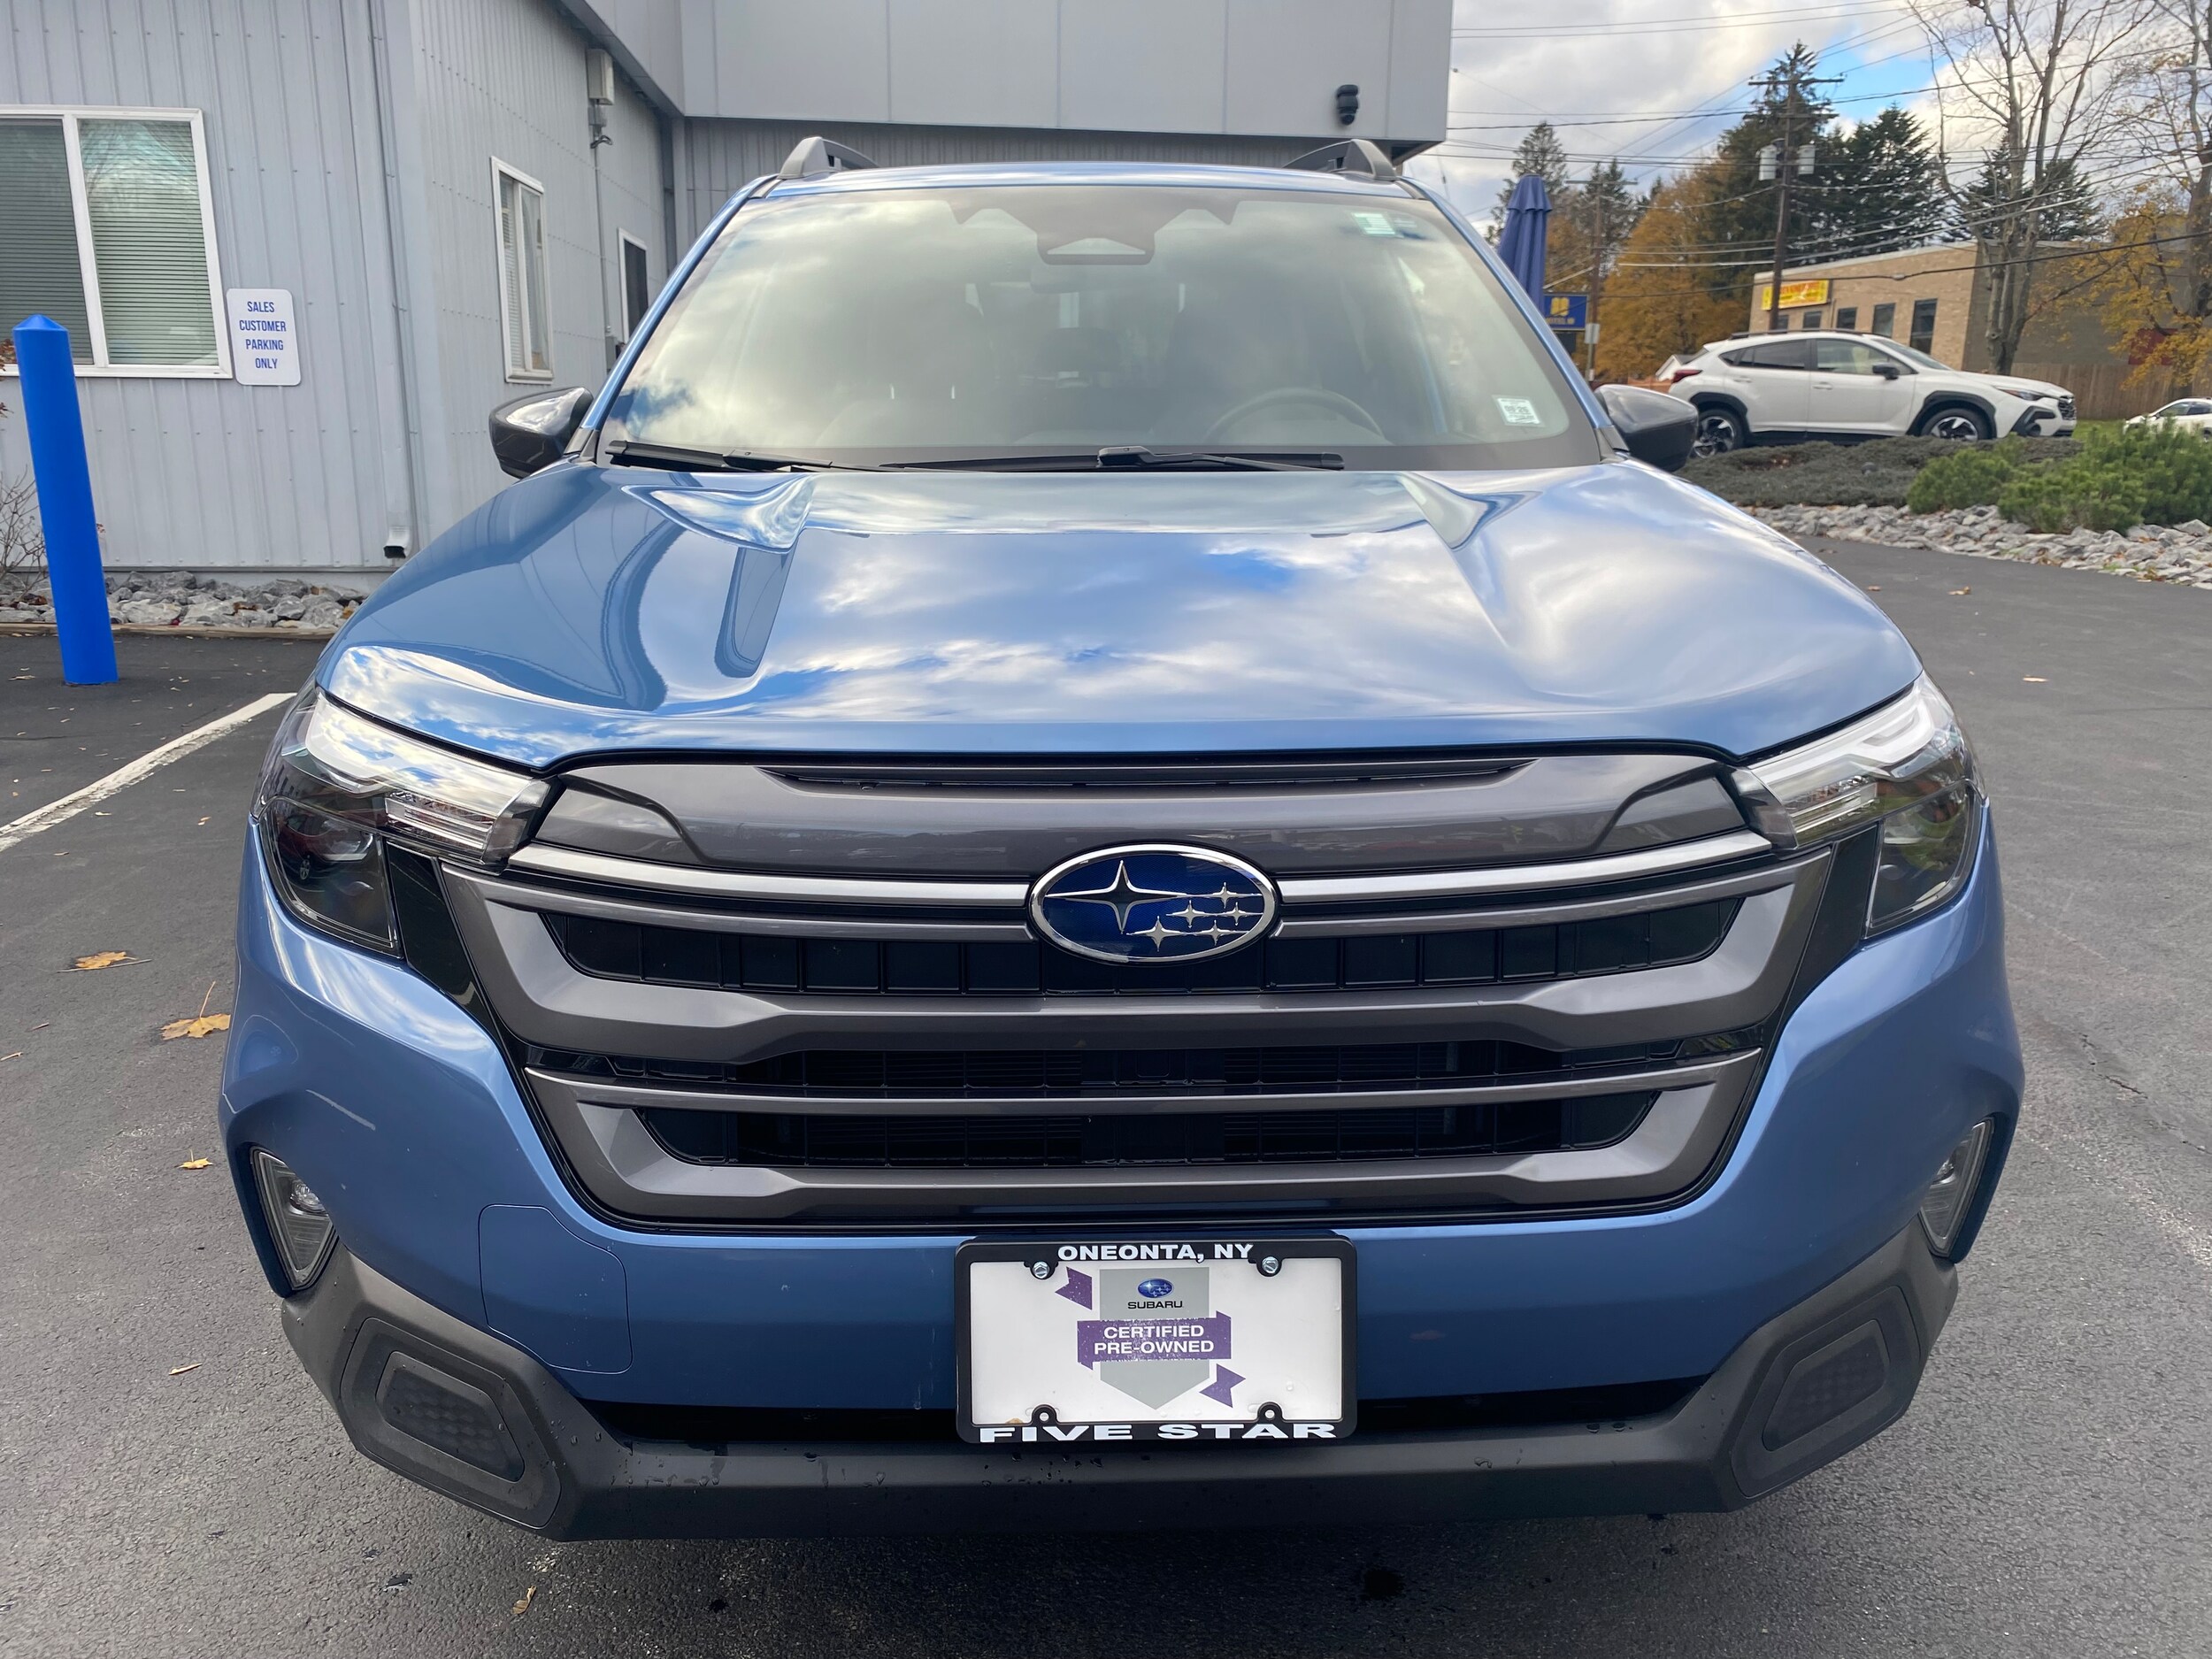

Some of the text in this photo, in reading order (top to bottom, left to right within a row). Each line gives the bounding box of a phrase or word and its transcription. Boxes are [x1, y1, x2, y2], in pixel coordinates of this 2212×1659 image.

[247, 301, 275, 312] SALES
[239, 319, 287, 332] CUSTOMER
[245, 339, 284, 350] PARKING
[255, 357, 278, 369] ONLY
[1057, 1244, 1254, 1263] ONEONTA, NY
[1127, 1301, 1183, 1310] SUBARU
[1103, 1325, 1204, 1339] CERTIFIED
[1094, 1340, 1215, 1355] PRE-OWNED
[979, 1424, 1337, 1443] FIVE STAR
